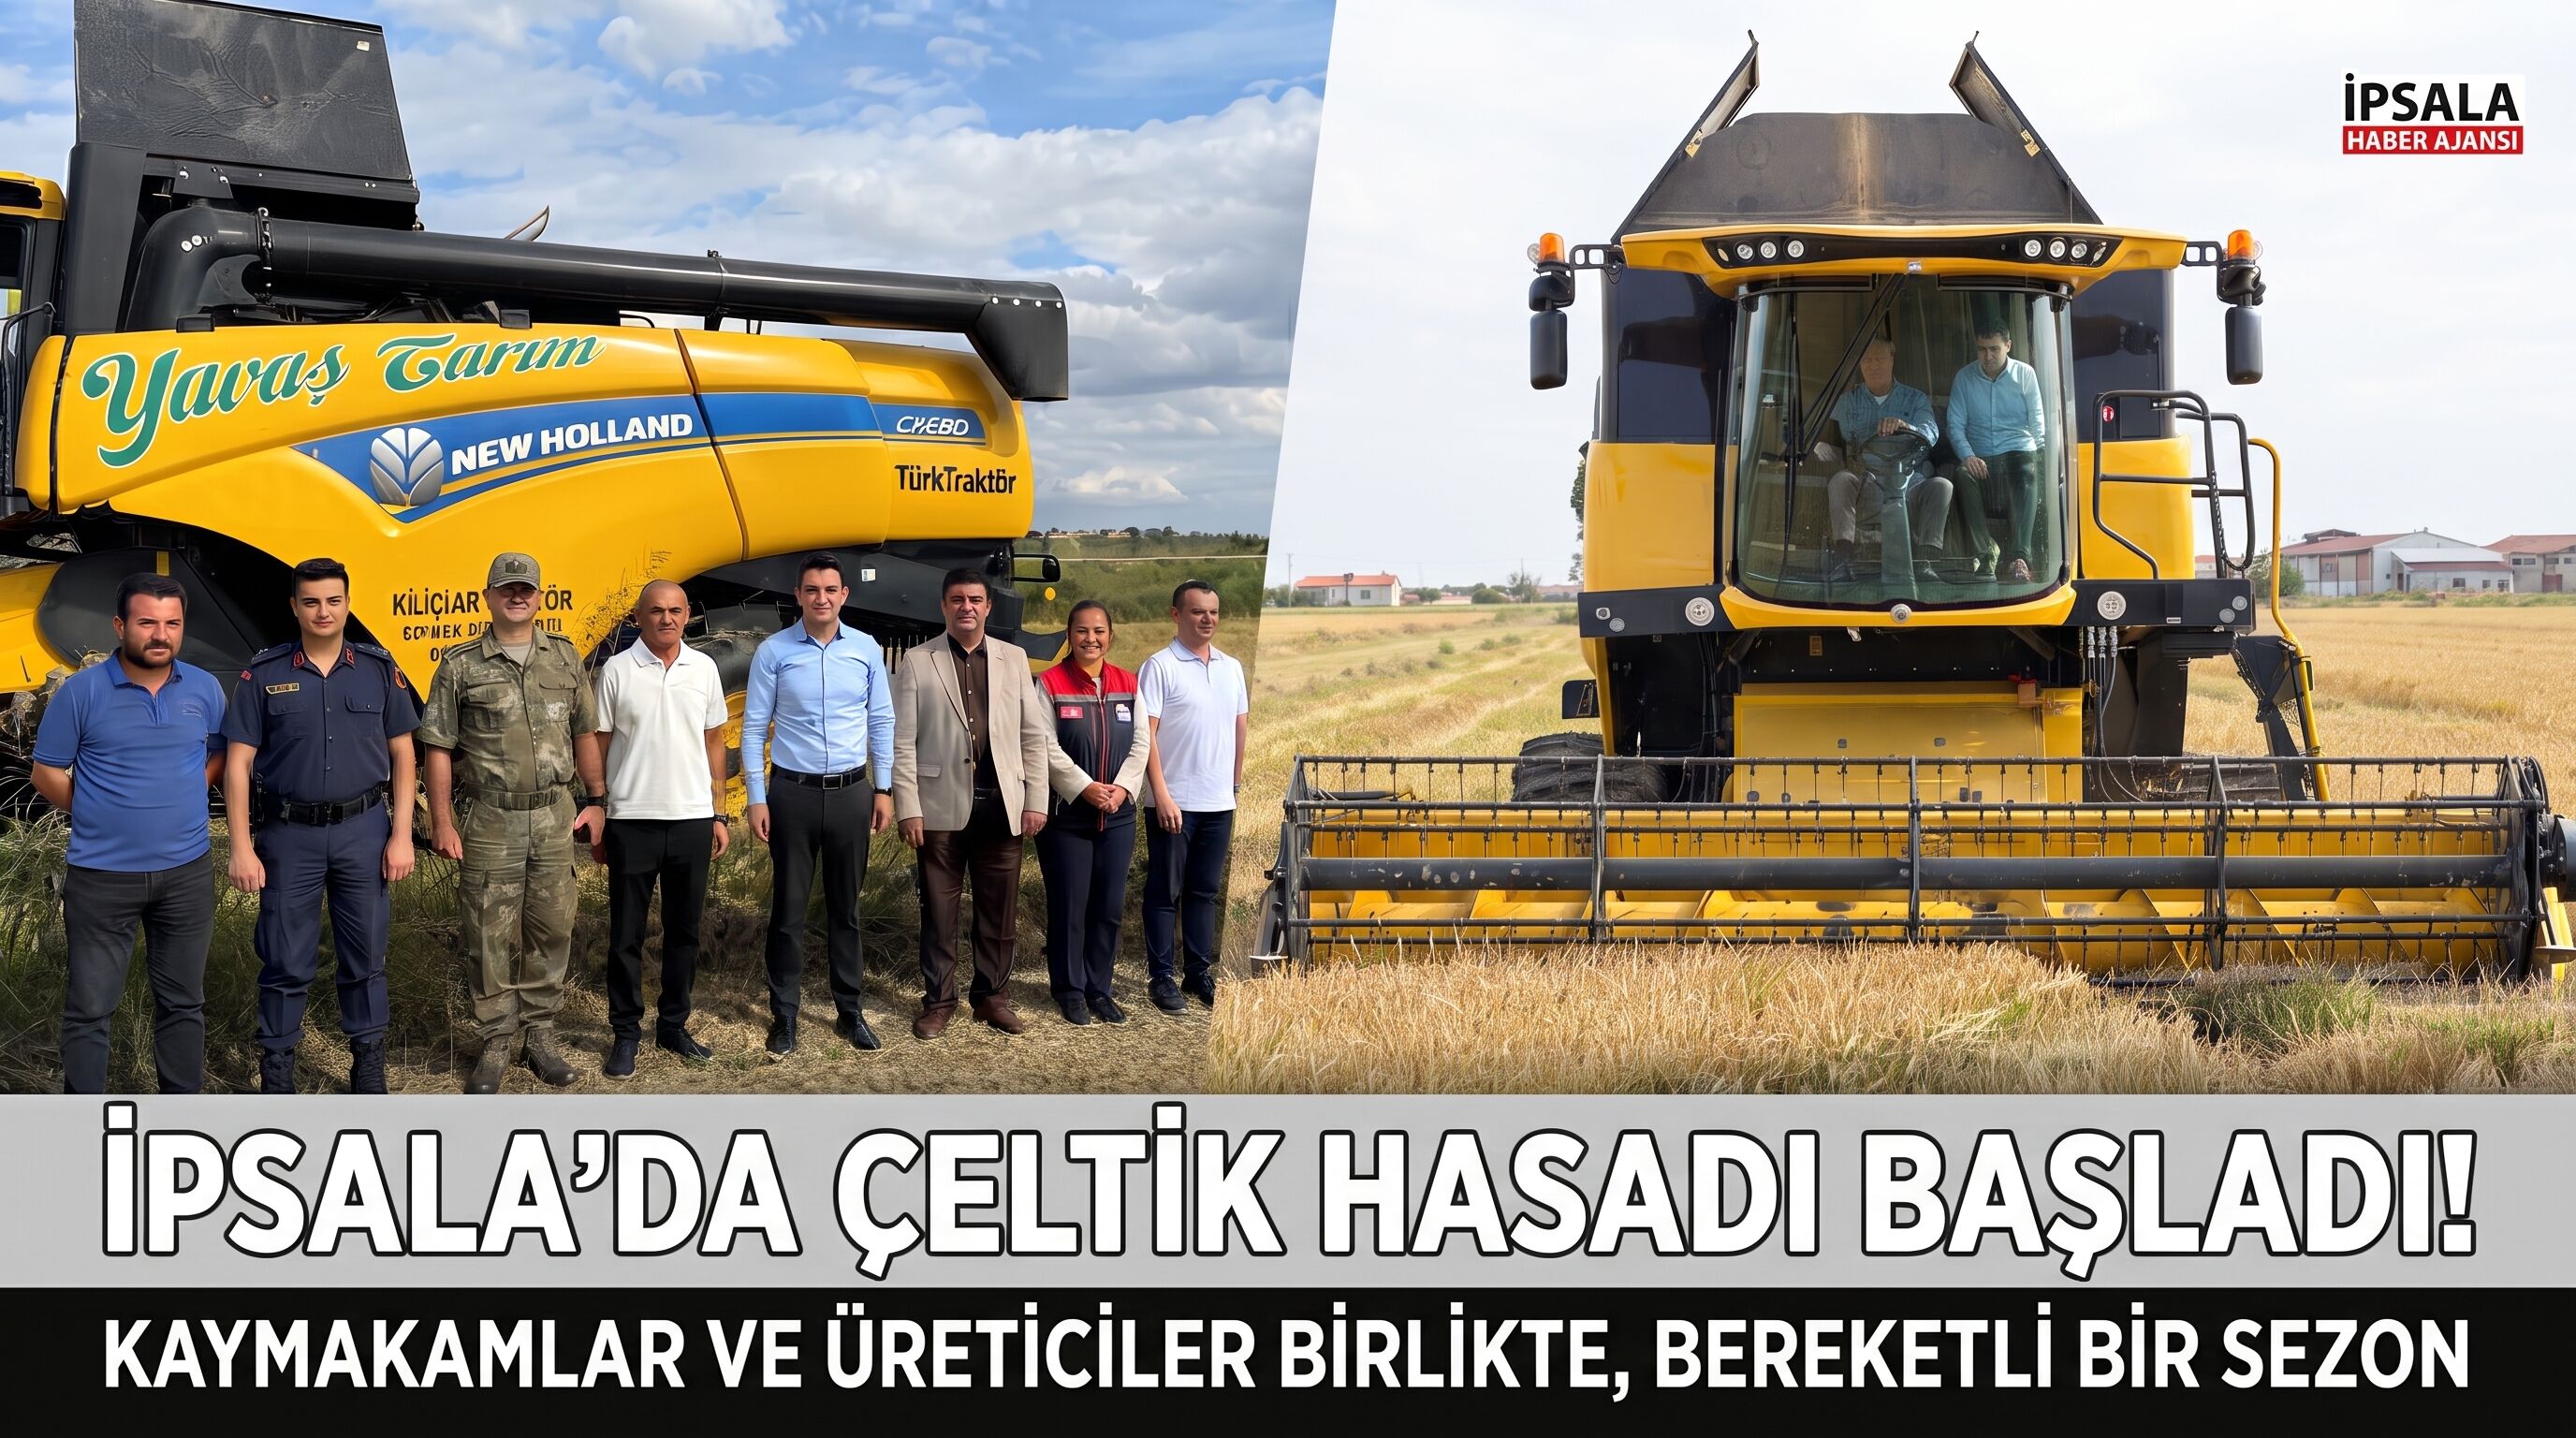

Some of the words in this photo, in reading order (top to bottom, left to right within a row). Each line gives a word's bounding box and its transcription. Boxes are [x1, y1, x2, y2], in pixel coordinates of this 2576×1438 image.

[82, 344, 350, 467] Yavaş
[377, 332, 606, 392] Tarım
[451, 432, 534, 476] NEW
[540, 414, 693, 455] HOLLAND
[894, 464, 1017, 494] TürkTraktör
